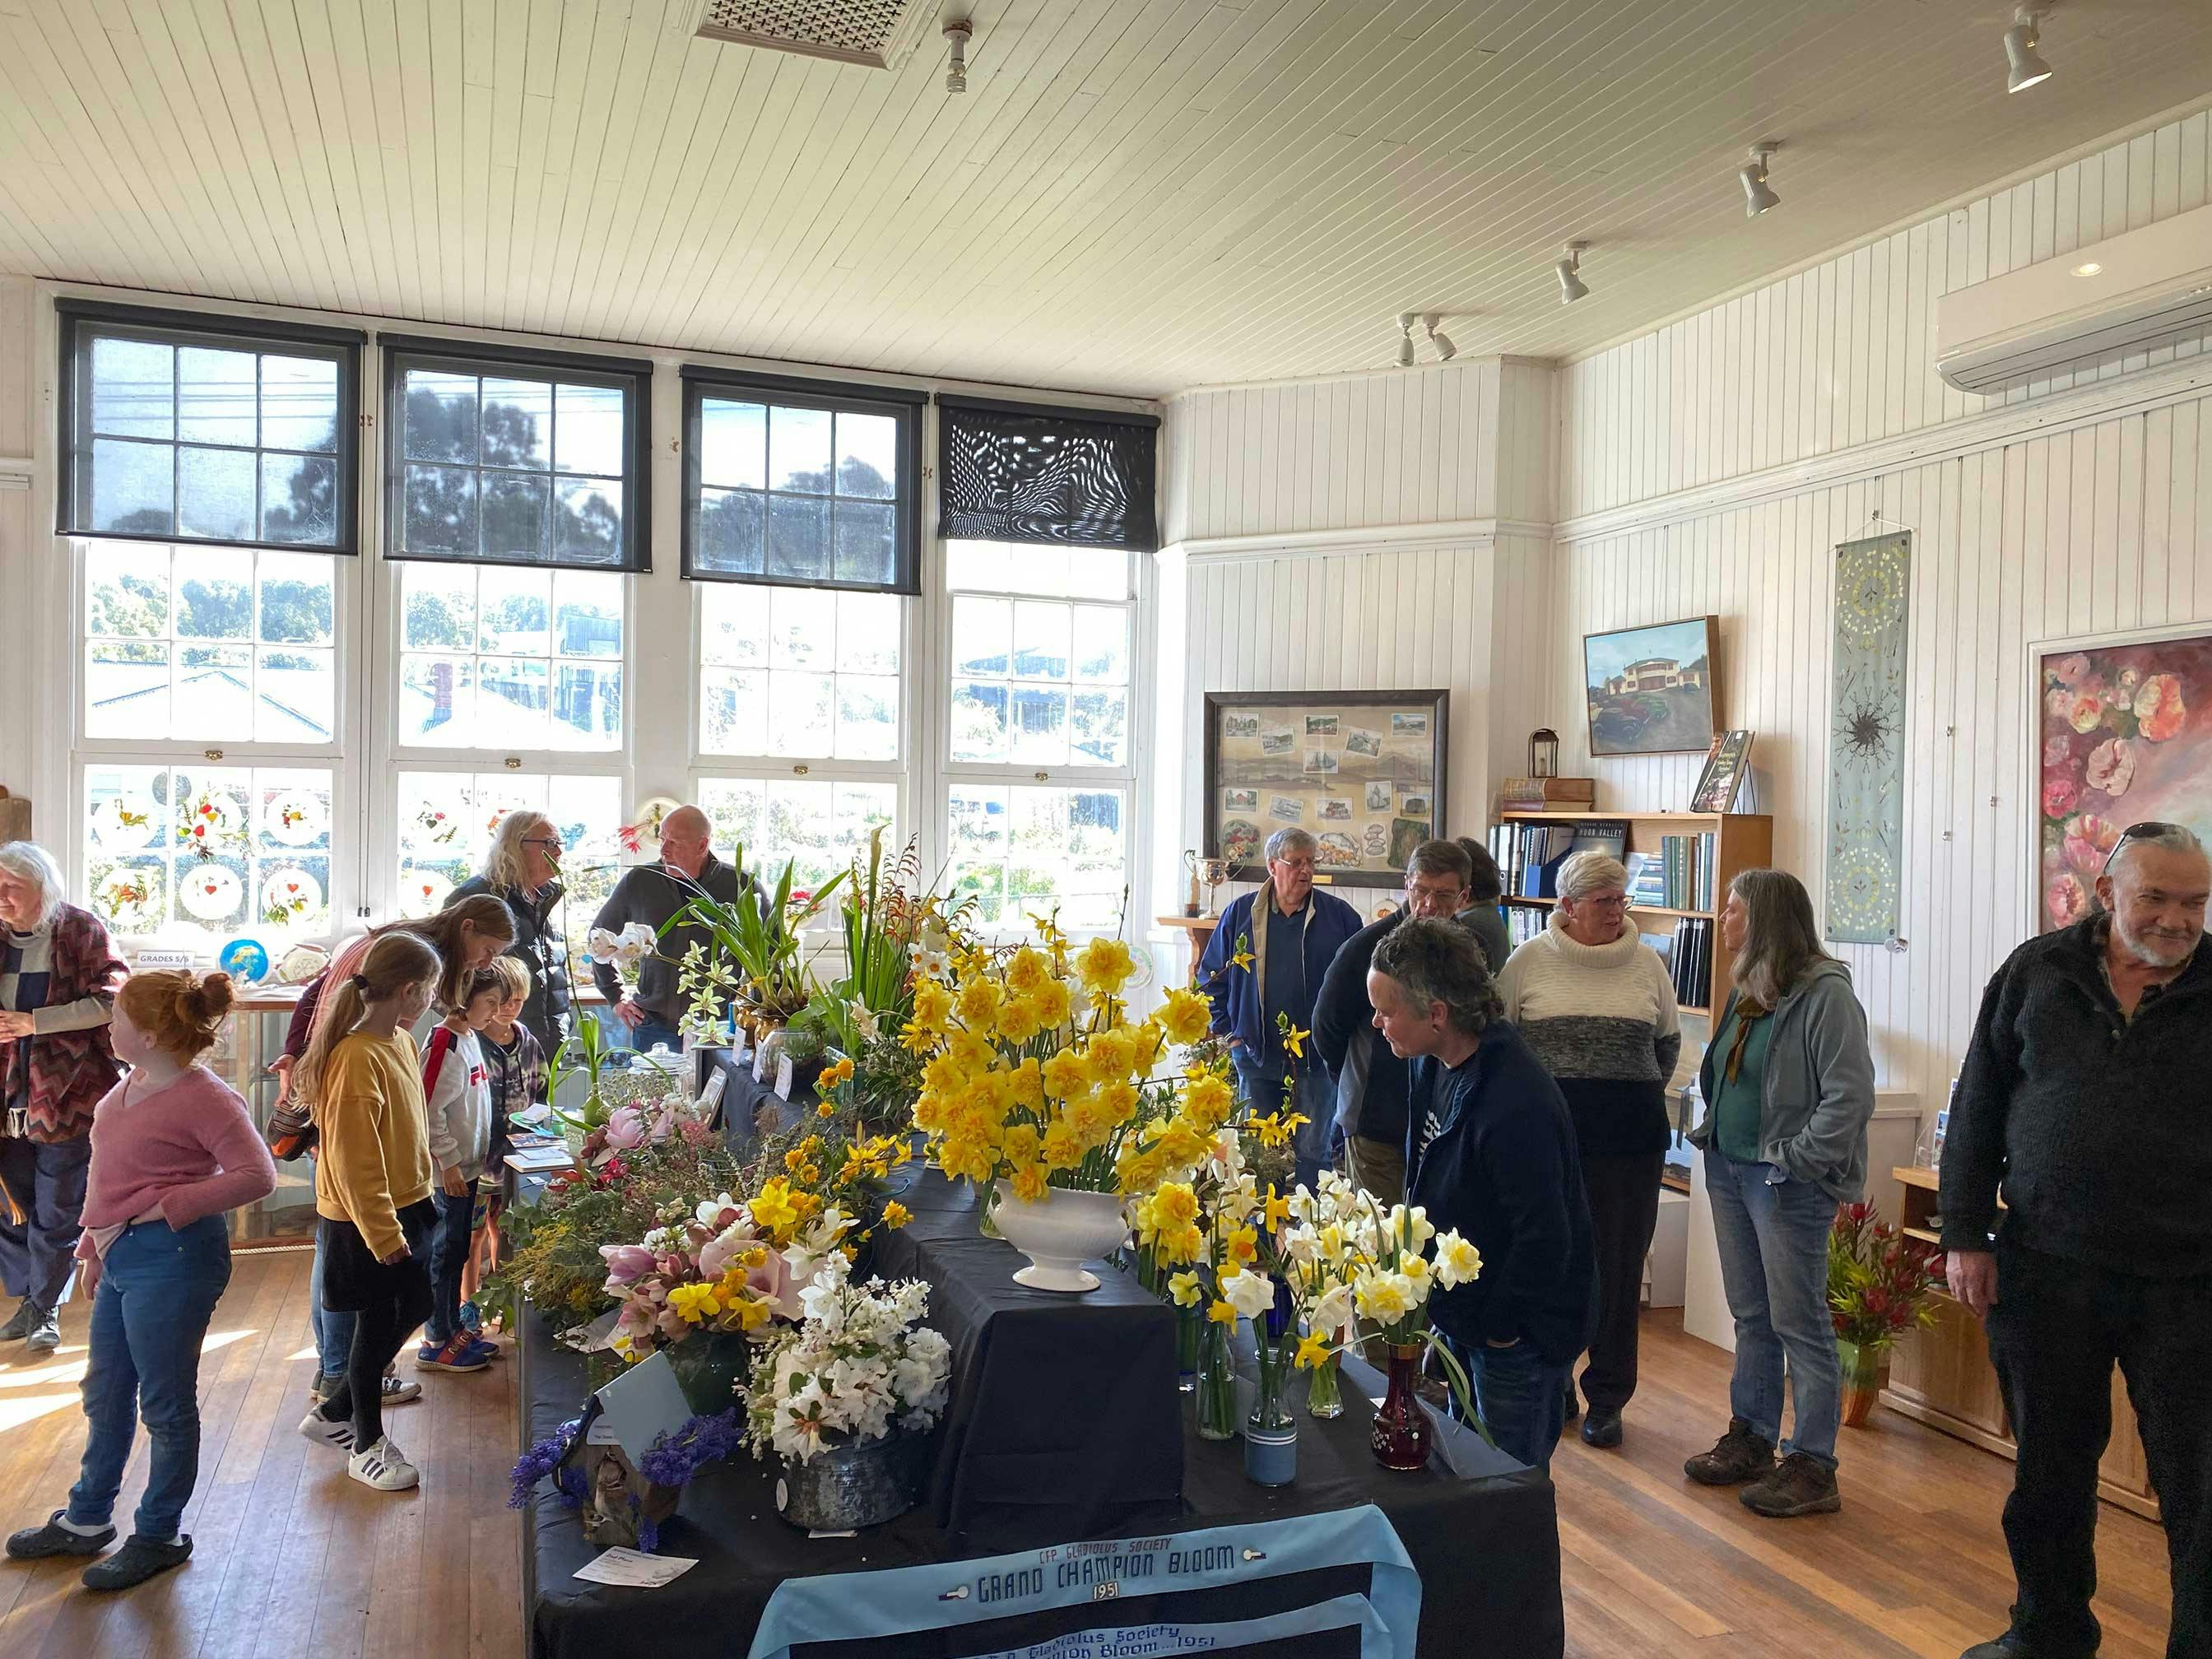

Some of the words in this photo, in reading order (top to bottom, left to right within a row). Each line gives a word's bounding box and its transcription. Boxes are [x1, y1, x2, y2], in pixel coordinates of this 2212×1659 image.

[1599, 828, 1622, 837] VALLEY
[1066, 1542, 1118, 1559] GLADIOLUS
[1128, 1537, 1173, 1554] SOCIETY
[978, 1567, 1043, 1603] GRAND
[1057, 1553, 1154, 1588] CHAMPION
[1168, 1544, 1234, 1574] BLOOM
[1093, 1582, 1119, 1600] 1951
[1115, 1625, 1180, 1644] Society
